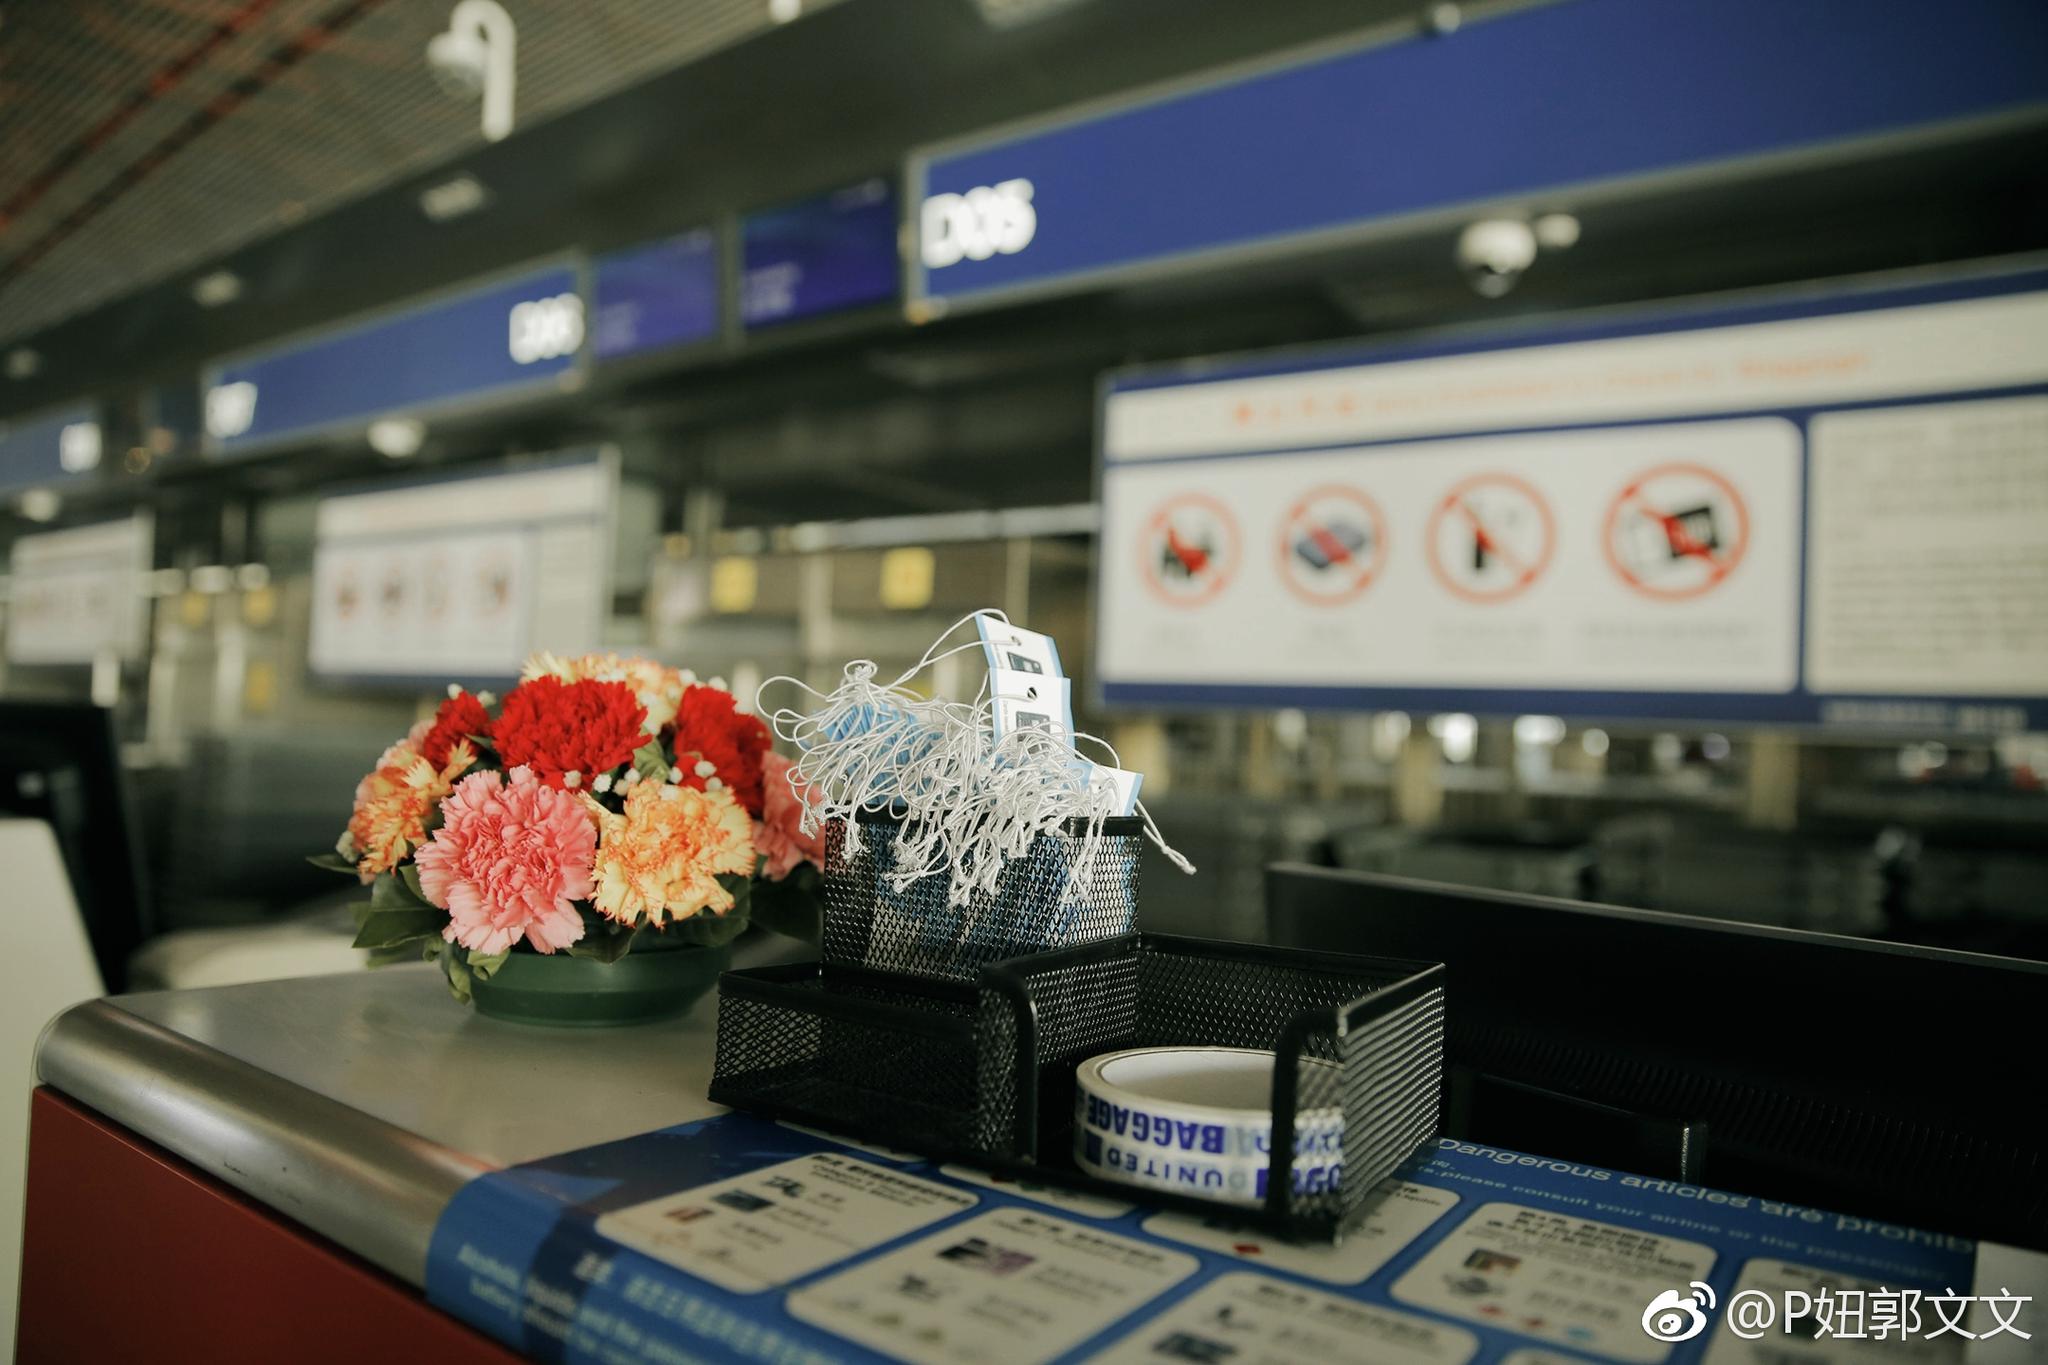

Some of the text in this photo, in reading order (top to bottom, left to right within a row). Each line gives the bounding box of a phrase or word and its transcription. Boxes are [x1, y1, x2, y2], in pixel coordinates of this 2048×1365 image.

[1088, 1094, 1225, 1154] BAGGAGE
[1107, 1147, 1222, 1188] UNITED
[1439, 1138, 1611, 1181] Dangerous
[1620, 1175, 1751, 1209] articles
[1760, 1199, 1823, 1224] are
[1513, 1184, 1590, 1207] consult
[1595, 1201, 1645, 1218] your
[1650, 1212, 1722, 1234] airline
